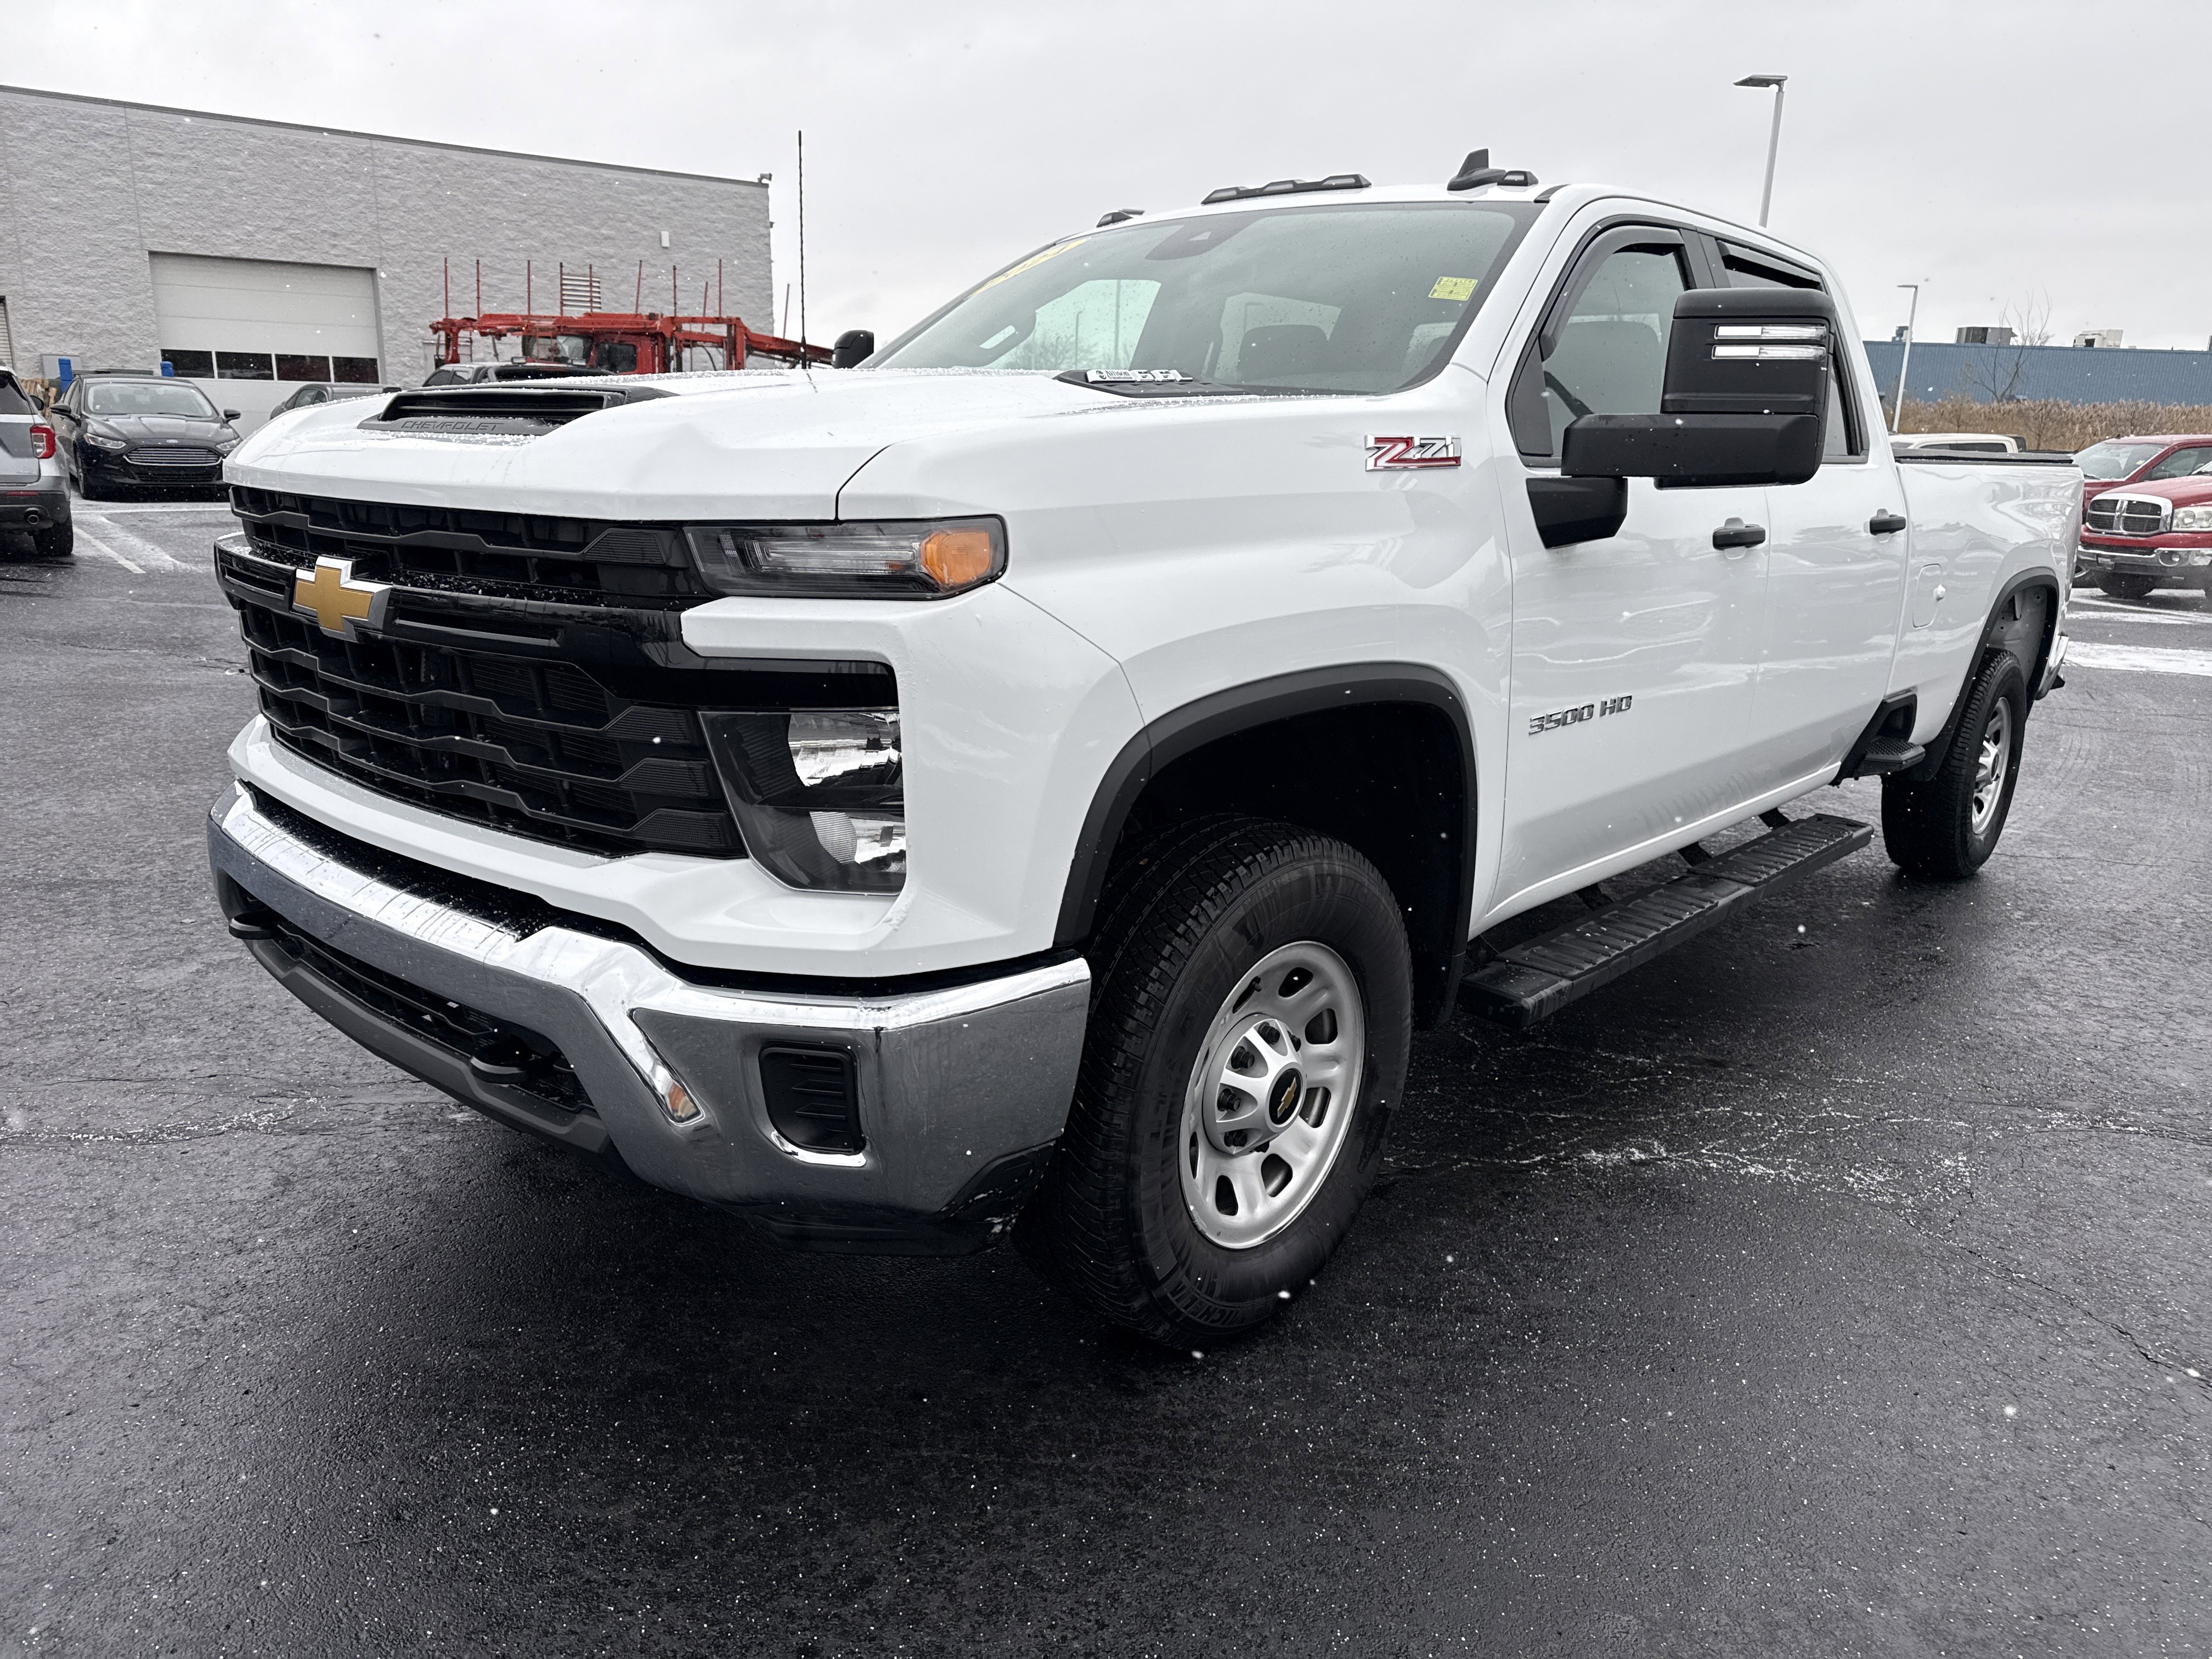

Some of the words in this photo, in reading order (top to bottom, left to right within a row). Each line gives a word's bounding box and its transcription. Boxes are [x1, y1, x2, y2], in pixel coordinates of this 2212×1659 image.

[400, 421, 504, 432] CHEVROLET
[1365, 435, 1462, 472] Z71
[1528, 703, 1594, 736] 3500
[1600, 693, 1633, 717] HD
